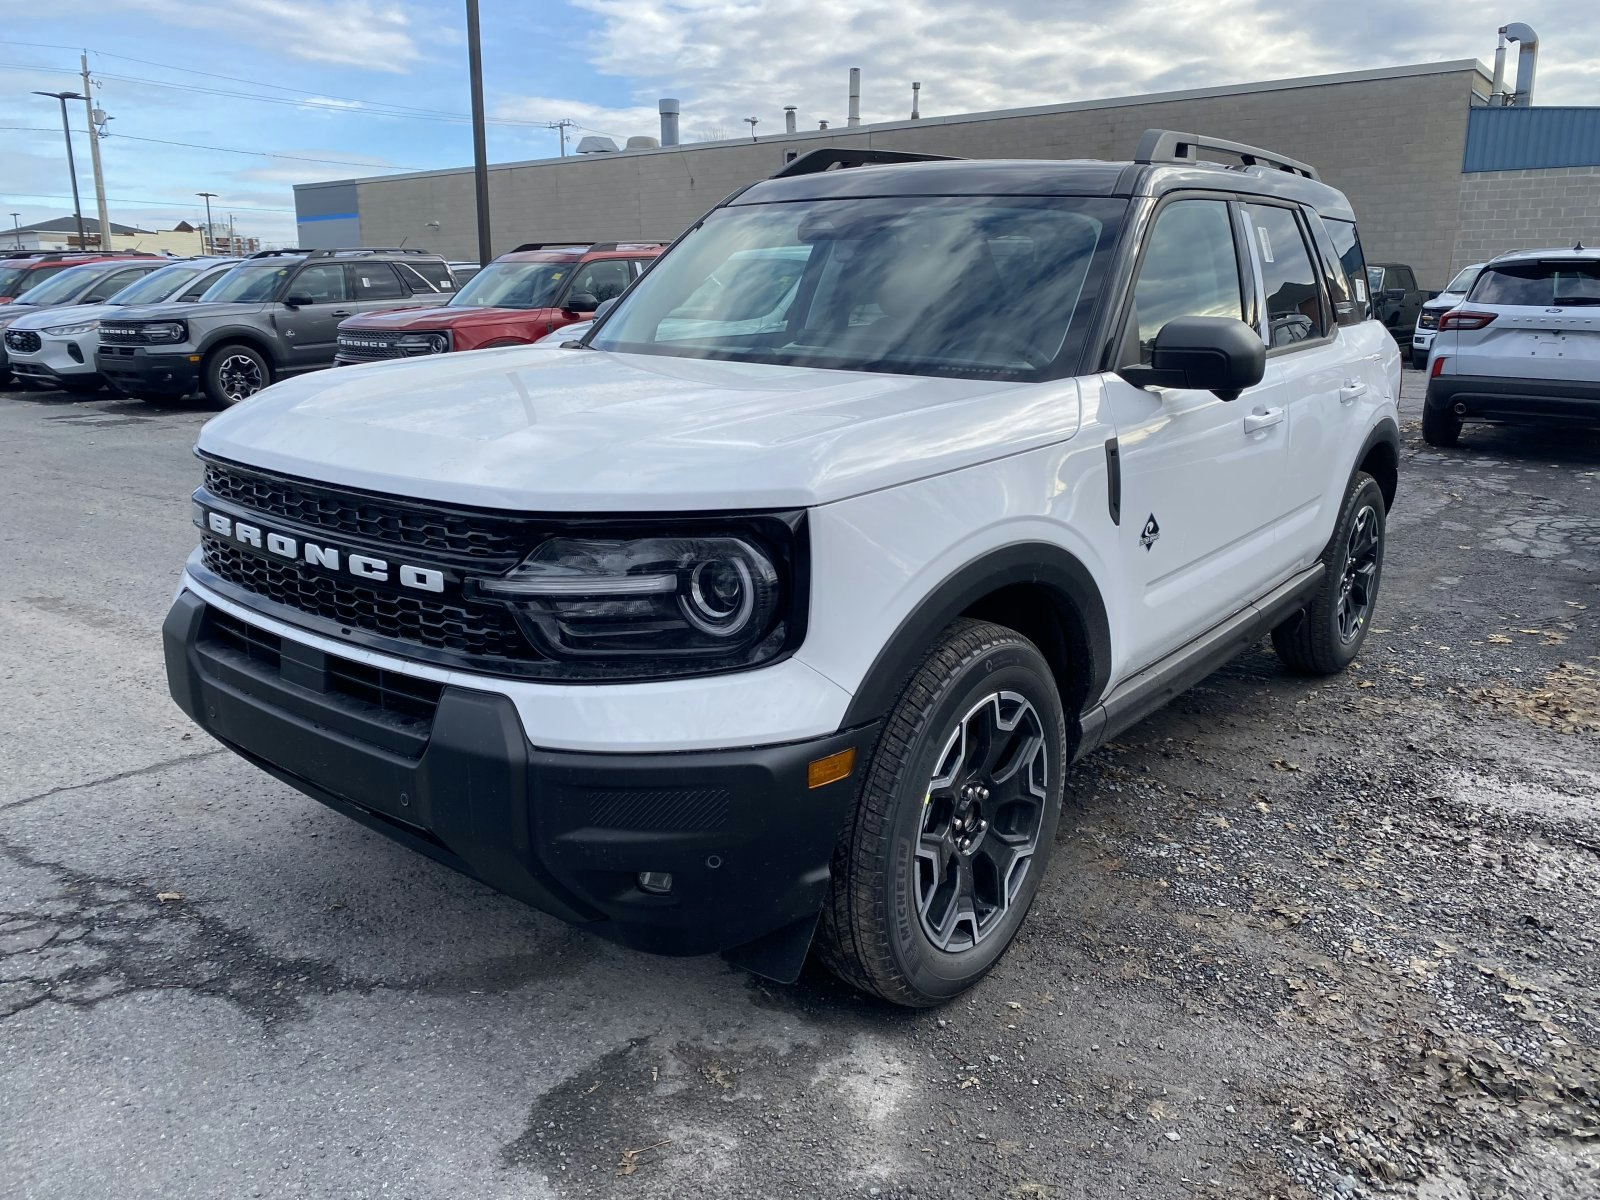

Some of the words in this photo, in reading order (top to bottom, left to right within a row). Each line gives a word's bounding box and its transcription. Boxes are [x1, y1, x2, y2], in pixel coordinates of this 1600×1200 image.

[340, 340, 388, 348] BRONCO
[208, 512, 444, 593] BRONCO
[896, 840, 911, 942] MICHELIN
